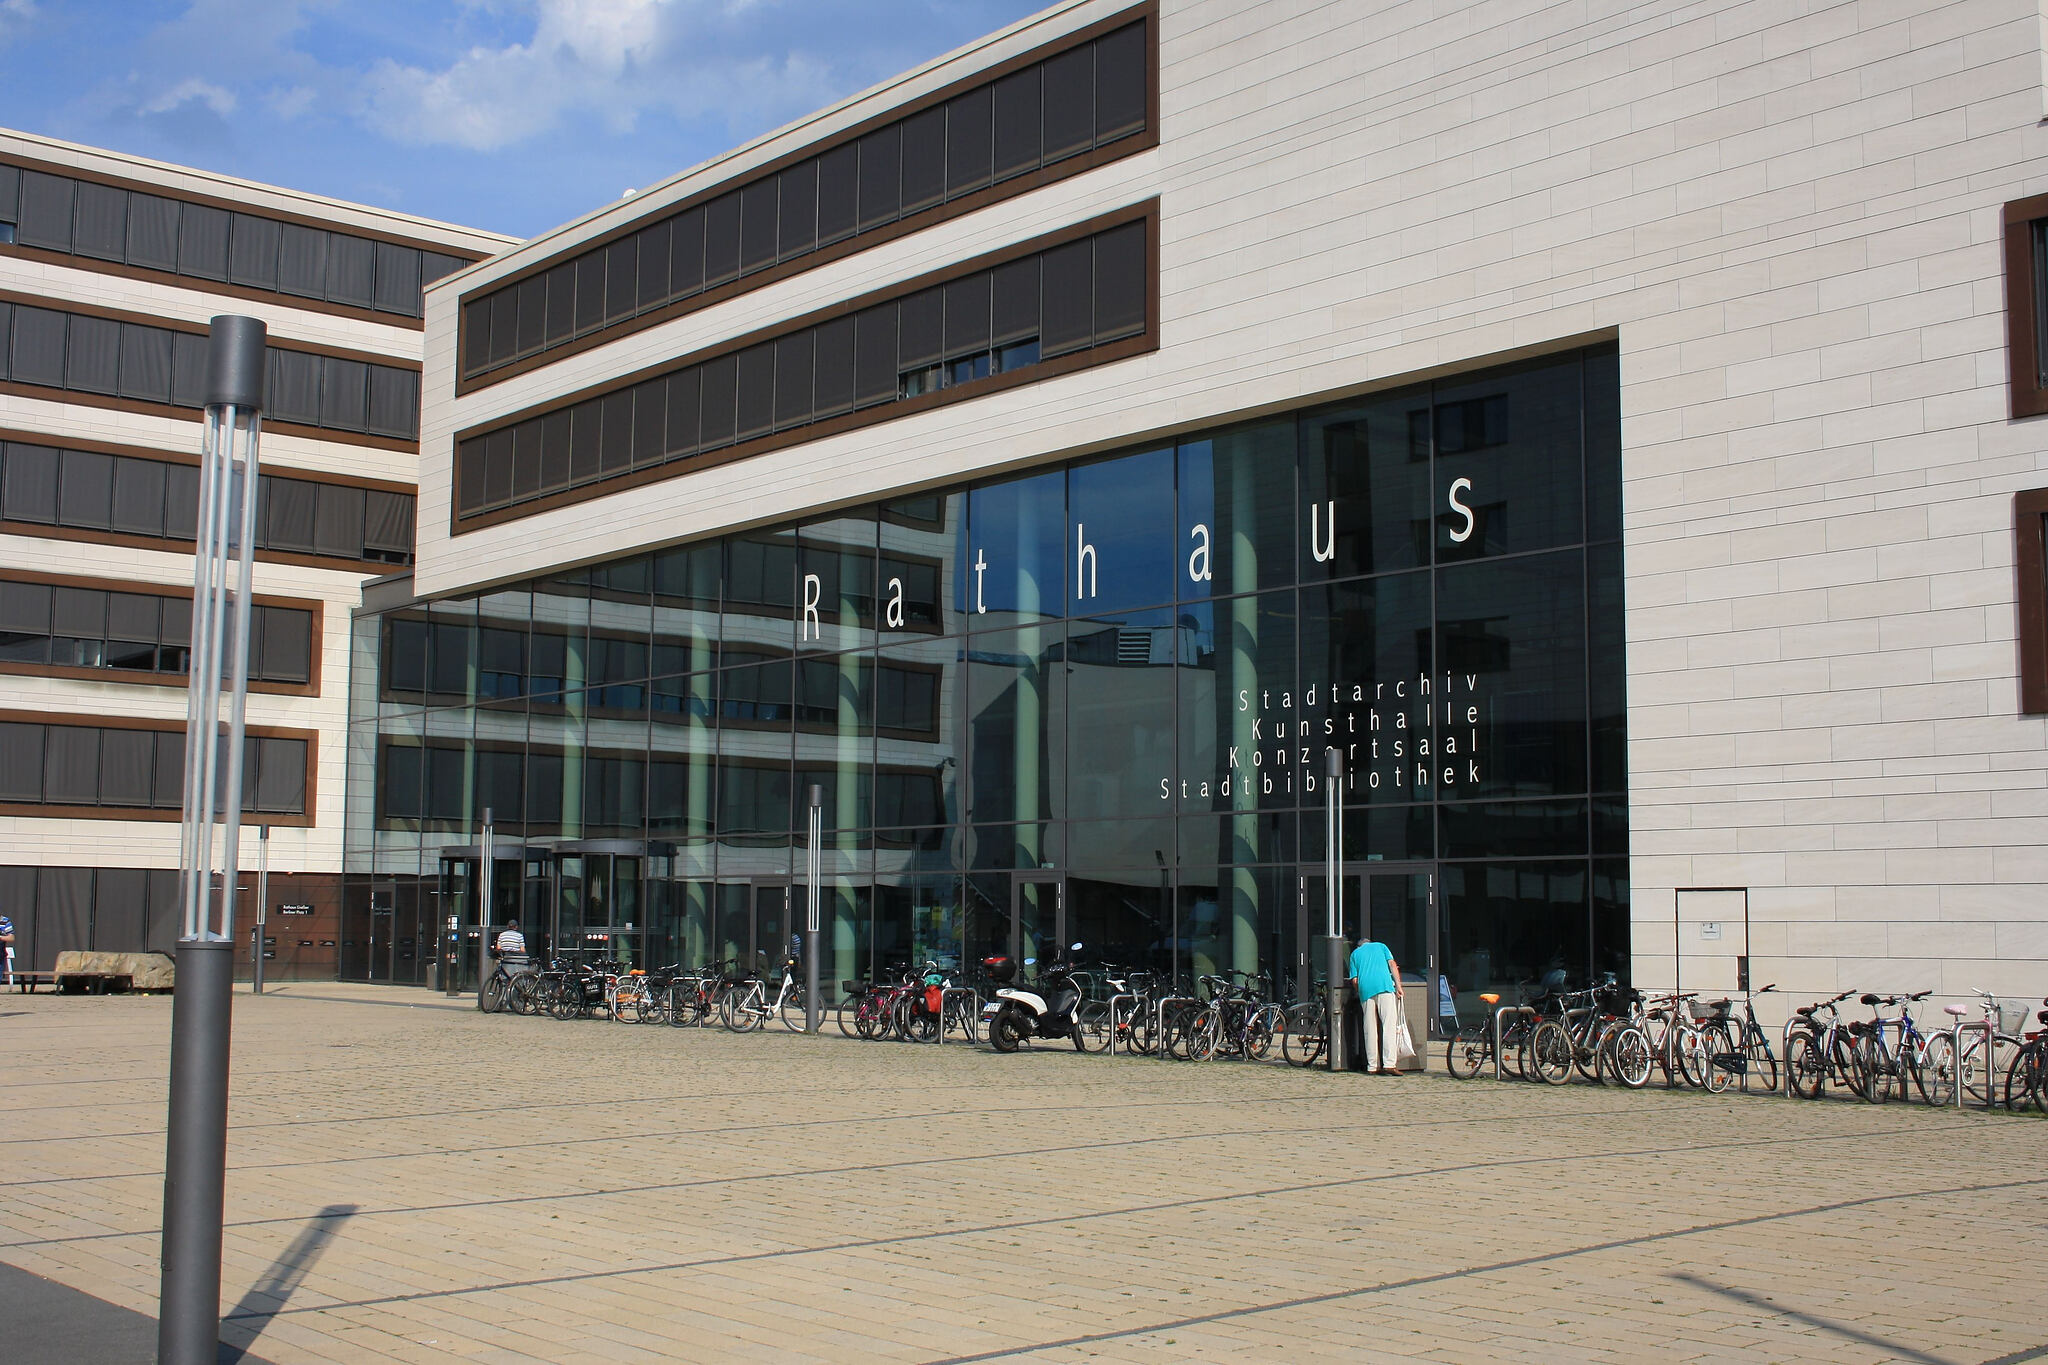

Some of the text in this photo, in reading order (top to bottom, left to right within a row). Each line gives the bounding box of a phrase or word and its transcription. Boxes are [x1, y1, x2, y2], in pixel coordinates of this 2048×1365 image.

[802, 477, 1475, 642] Rathaus
[1239, 671, 1477, 711] Stadtarchiv
[1252, 702, 1478, 740] Kunsthalle
[1160, 759, 1480, 800] Stadtbibiothek
